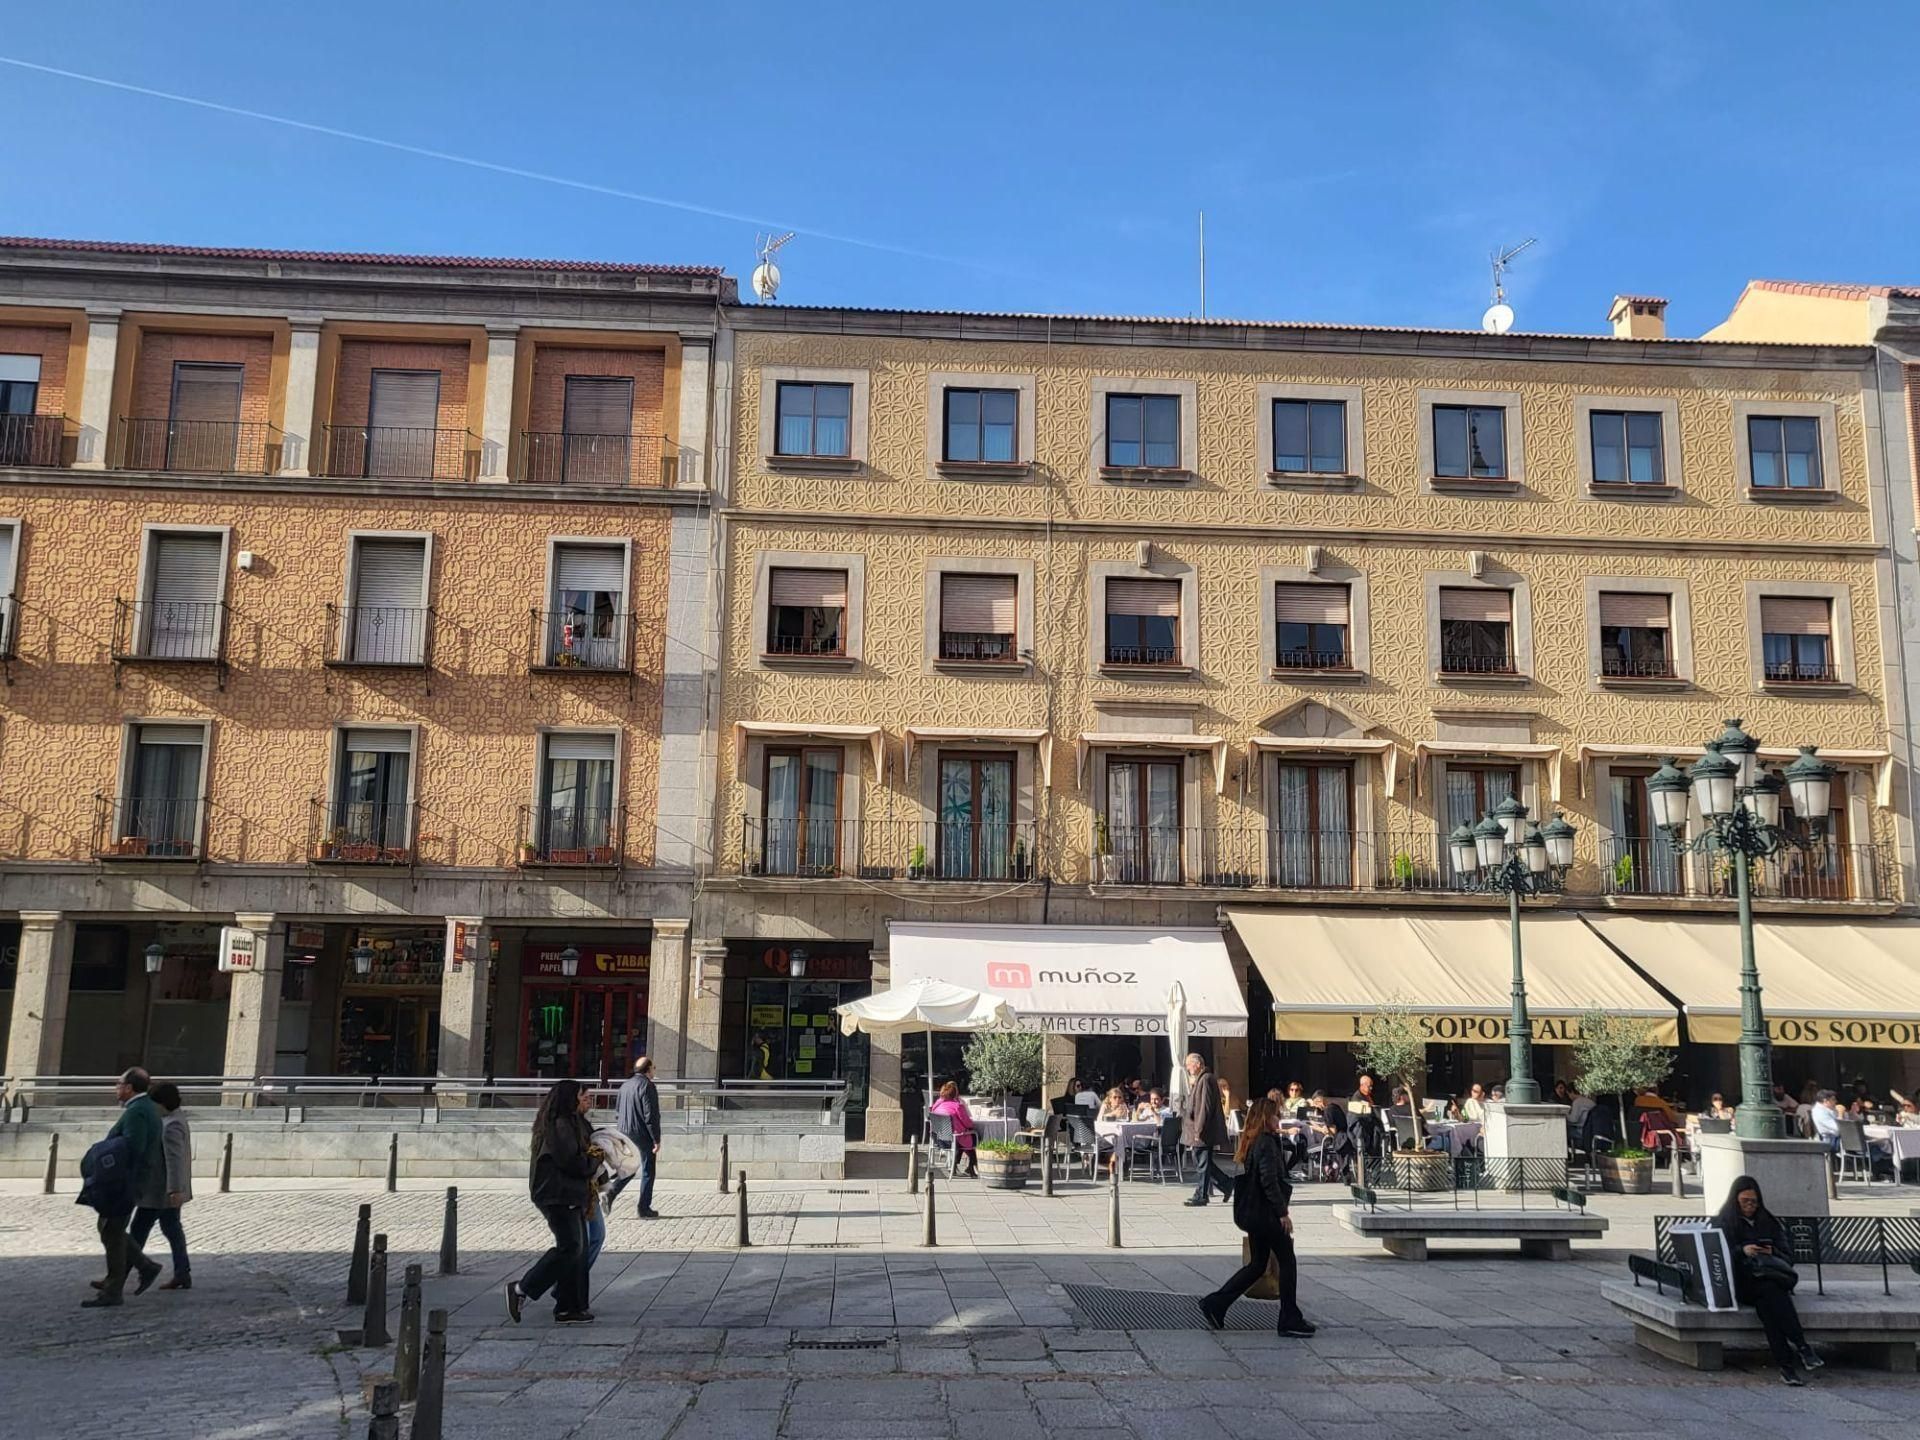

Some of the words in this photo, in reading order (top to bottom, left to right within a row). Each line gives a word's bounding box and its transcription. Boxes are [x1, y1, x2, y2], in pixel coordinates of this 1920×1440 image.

[540, 951, 562, 961] PREN
[1039, 967, 1139, 984] muñoz
[1040, 1016, 1121, 1033] MALETAS
[1134, 1018, 1208, 1034] BOLOS
[1418, 1016, 1611, 1041] SOPOTAL
[1765, 1020, 1819, 1041] LOS
